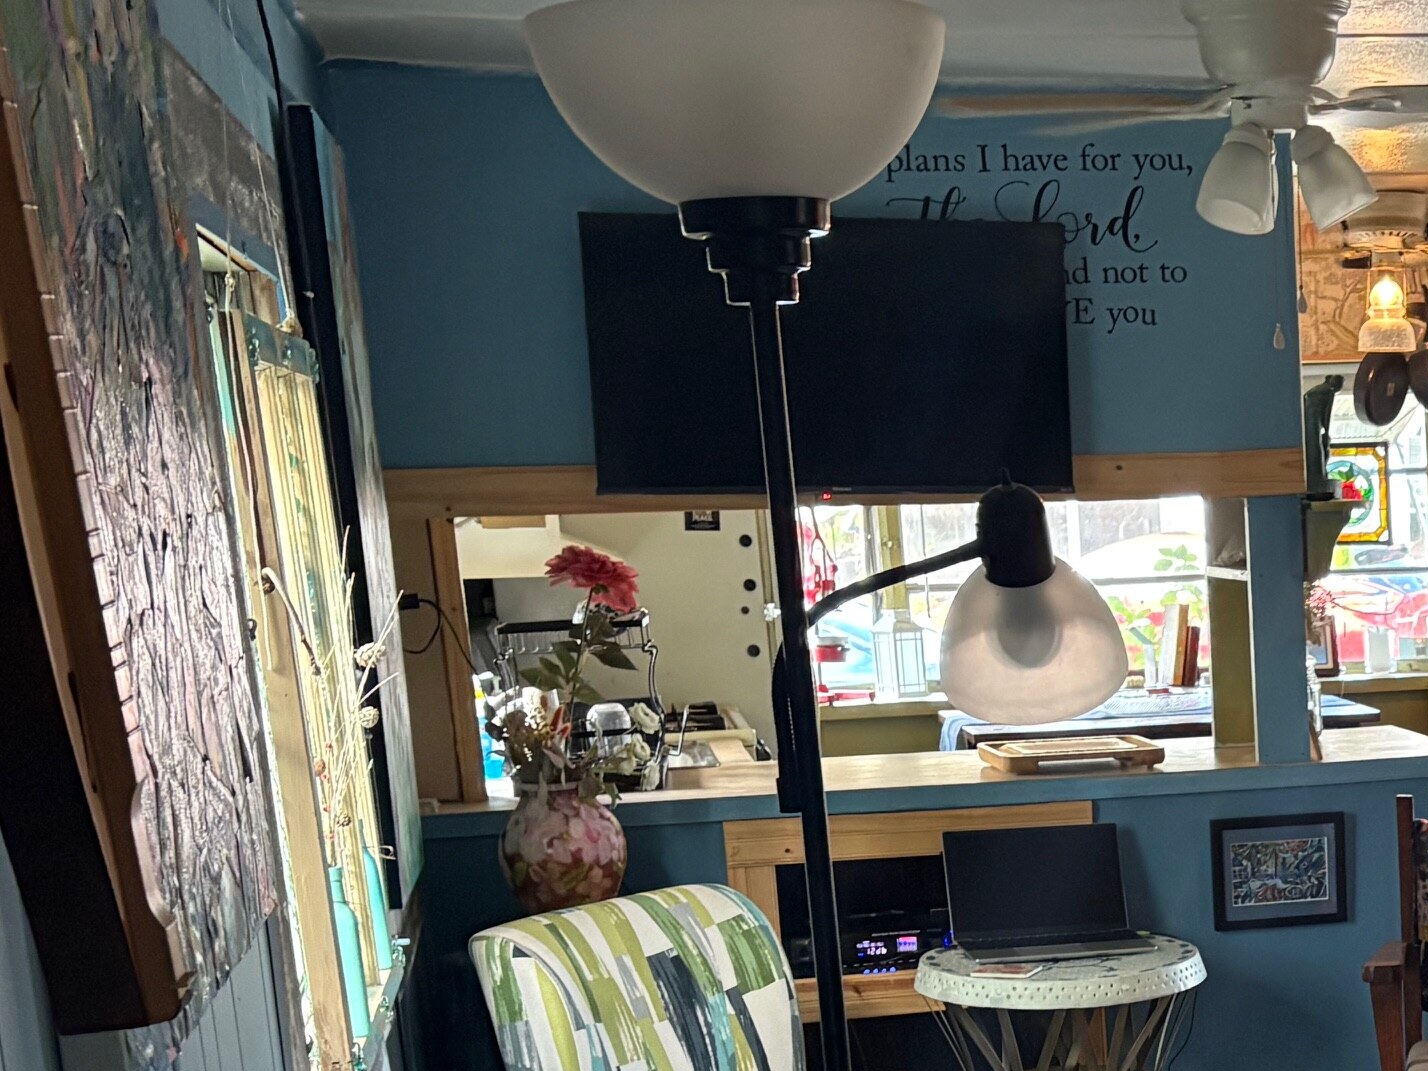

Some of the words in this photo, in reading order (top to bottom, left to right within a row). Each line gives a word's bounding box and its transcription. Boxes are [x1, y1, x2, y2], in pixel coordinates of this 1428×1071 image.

[886, 144, 966, 183] plans
[976, 145, 992, 173] I
[1001, 144, 1069, 172] have
[1080, 142, 1122, 172] for
[1133, 151, 1194, 179] you,
[1102, 262, 1149, 284] not
[1159, 259, 1188, 284] to
[1106, 305, 1158, 334] you
